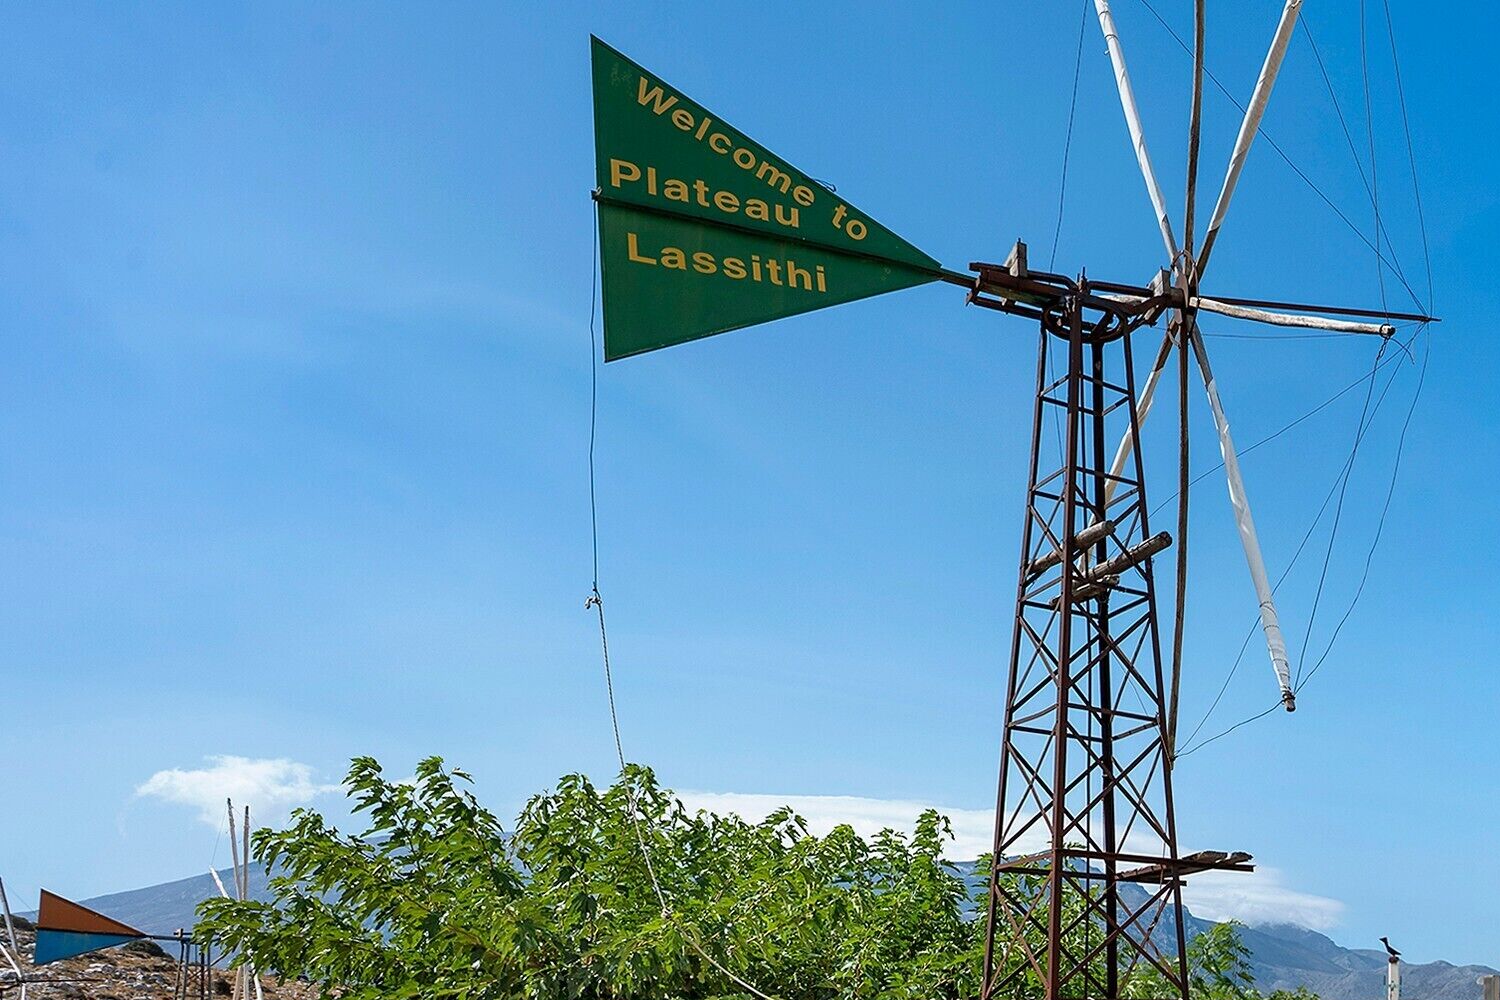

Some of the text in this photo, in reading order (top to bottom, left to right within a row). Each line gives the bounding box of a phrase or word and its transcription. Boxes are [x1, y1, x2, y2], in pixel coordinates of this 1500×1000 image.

[635, 75, 867, 240] Welcome to
[610, 158, 799, 228] Plateau
[628, 232, 826, 292] Lassithi
